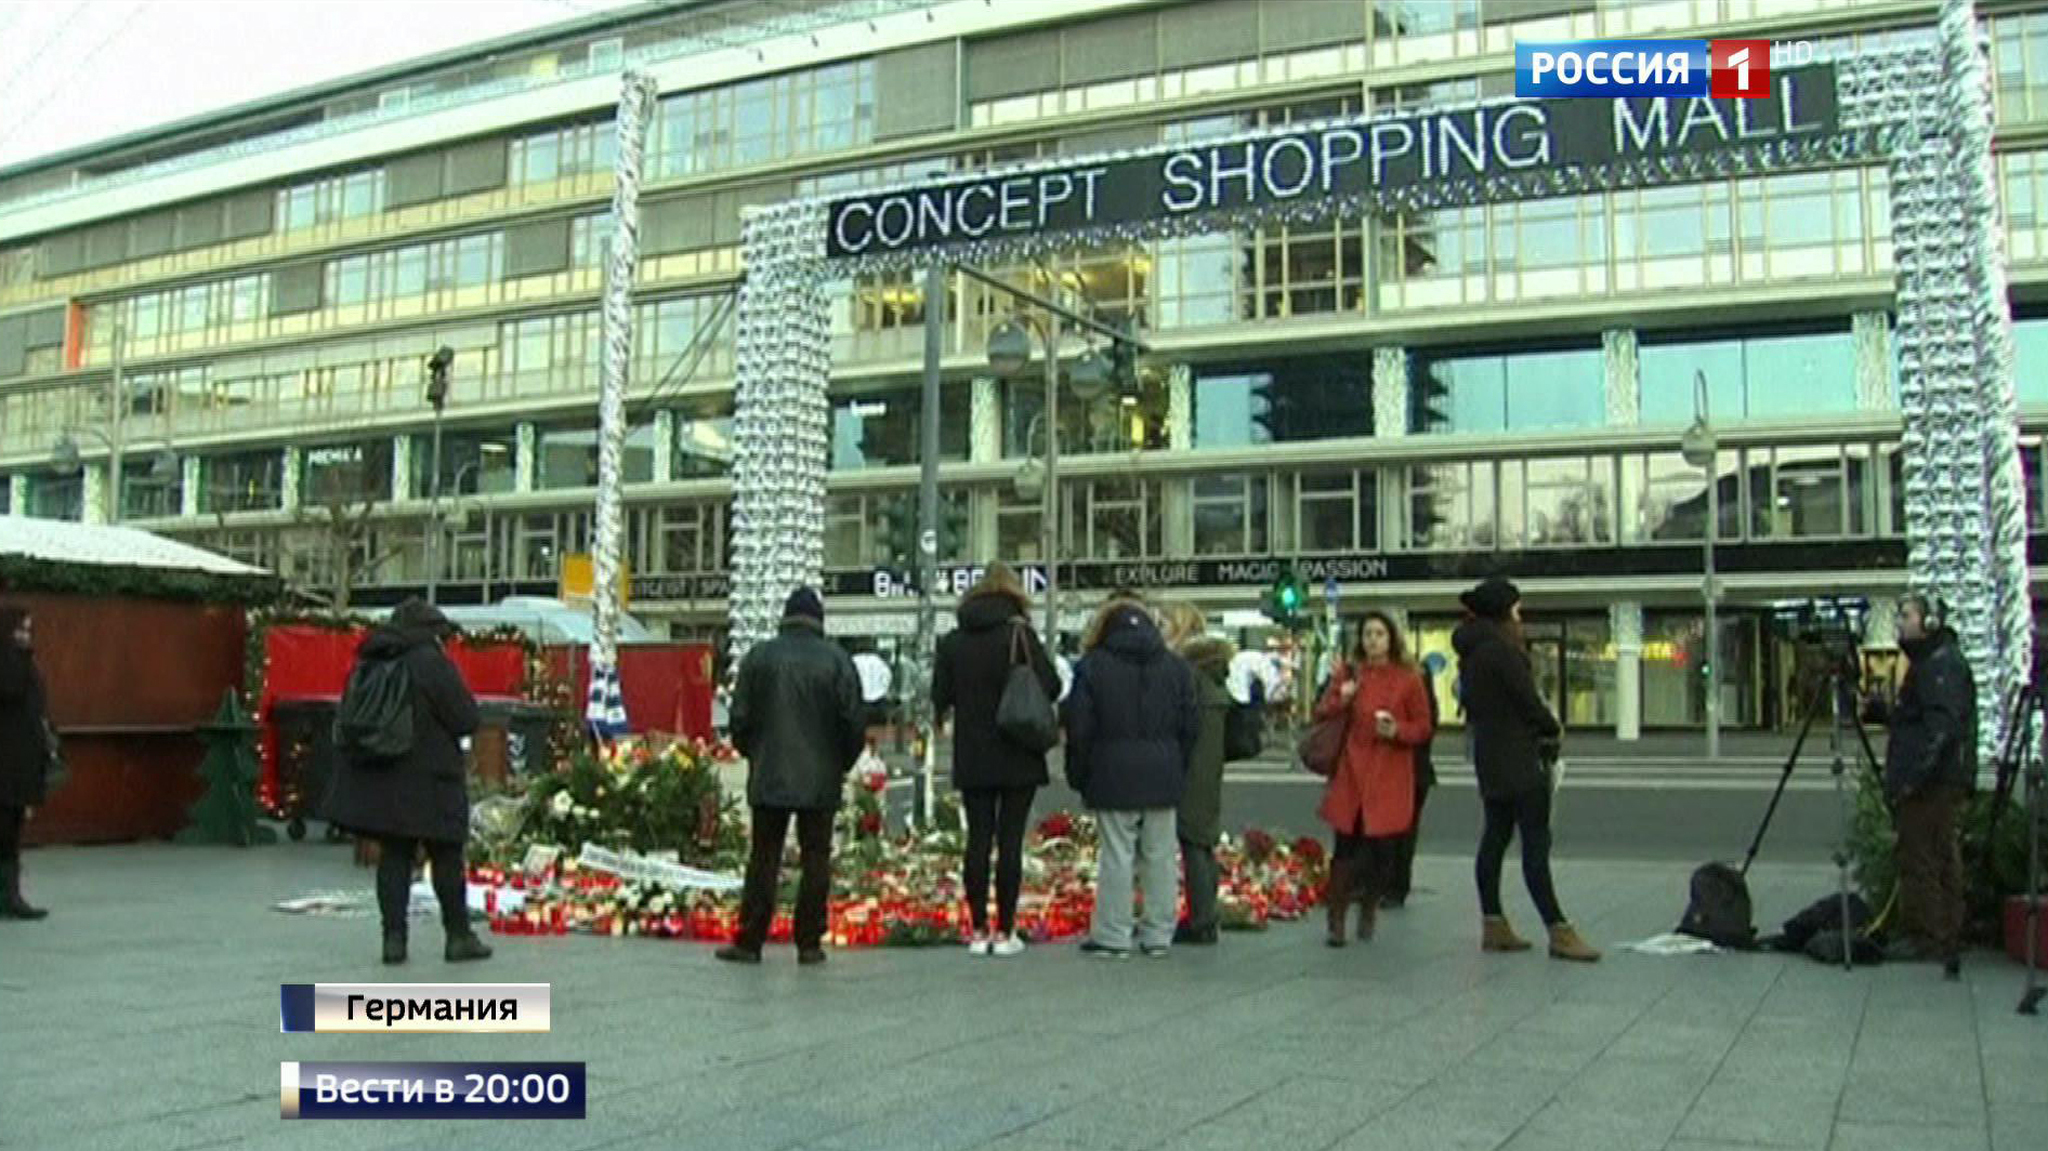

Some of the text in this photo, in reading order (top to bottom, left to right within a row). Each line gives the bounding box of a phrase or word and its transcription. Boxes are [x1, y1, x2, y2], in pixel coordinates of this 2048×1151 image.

[836, 74, 1823, 253] CONCEPT SHOPPING MALL
[1115, 558, 1388, 586] EXPLORE MAGIC PASSION
